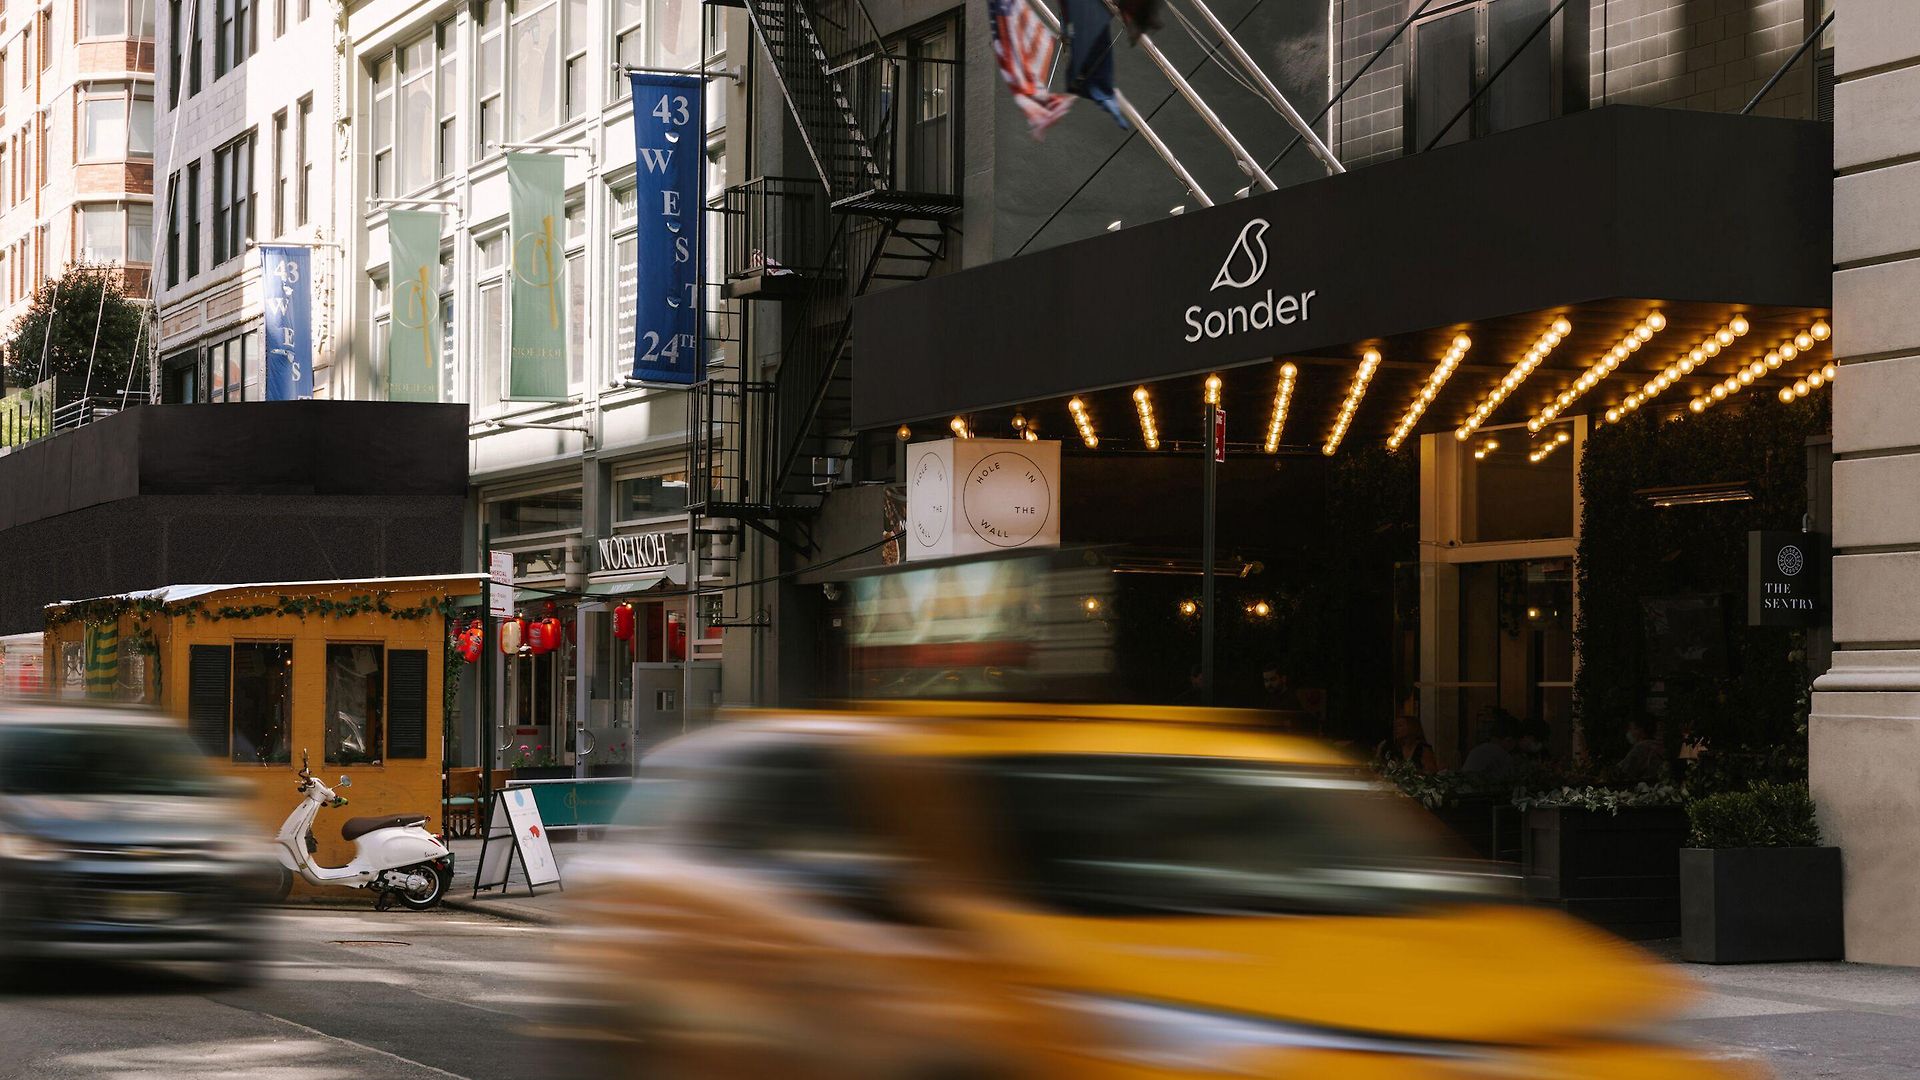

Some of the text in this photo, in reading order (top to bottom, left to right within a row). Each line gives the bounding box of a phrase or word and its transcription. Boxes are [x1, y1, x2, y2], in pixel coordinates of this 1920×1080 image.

[652, 94, 690, 126] 43
[272, 260, 299, 284] 43
[1184, 288, 1316, 343] Sonder
[266, 297, 311, 401] WES
[916, 463, 928, 487] HOLE
[976, 461, 1036, 485] HOLE IN
[932, 505, 943, 513] THE
[1014, 506, 1035, 514] THE
[918, 522, 931, 538] WALL
[981, 518, 1009, 538] WALL
[598, 533, 669, 570] NORIKOH
[1764, 582, 1791, 594] THE
[1764, 598, 1813, 609] SENTRY
